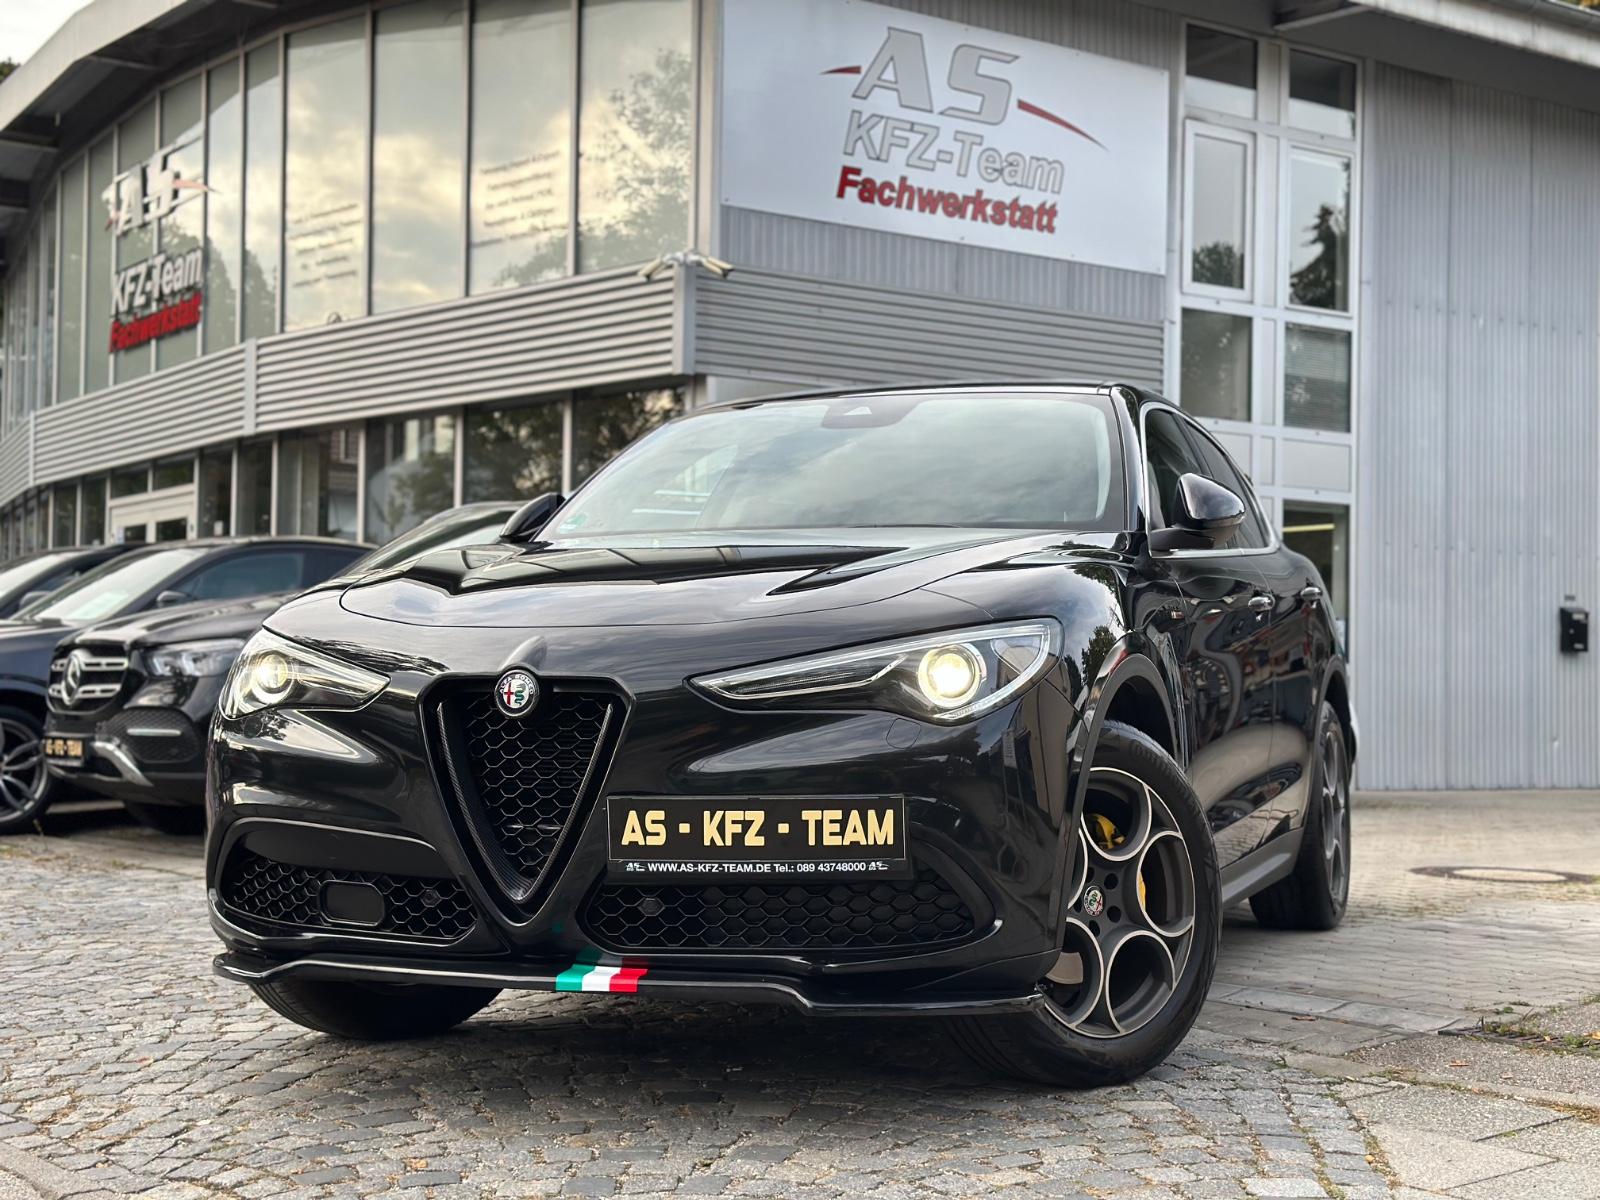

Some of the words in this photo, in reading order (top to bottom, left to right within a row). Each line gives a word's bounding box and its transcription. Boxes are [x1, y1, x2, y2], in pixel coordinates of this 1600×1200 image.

[851, 26, 1021, 126] AS
[843, 109, 1065, 195] KFZ-Team
[836, 165, 1059, 234] Fachwerkstatt
[111, 249, 204, 318] KFZ-Team
[499, 676, 513, 694] ALFA
[514, 673, 534, 695] ROMEO
[621, 809, 667, 846] AS
[703, 810, 766, 846] KFZ
[801, 809, 894, 846] TEAM
[647, 862, 772, 873] WWW.AS-KFZ-TEAM.DE
[773, 863, 795, 873] Tel.:
[796, 863, 816, 873] 089
[817, 862, 867, 872] 43748000
